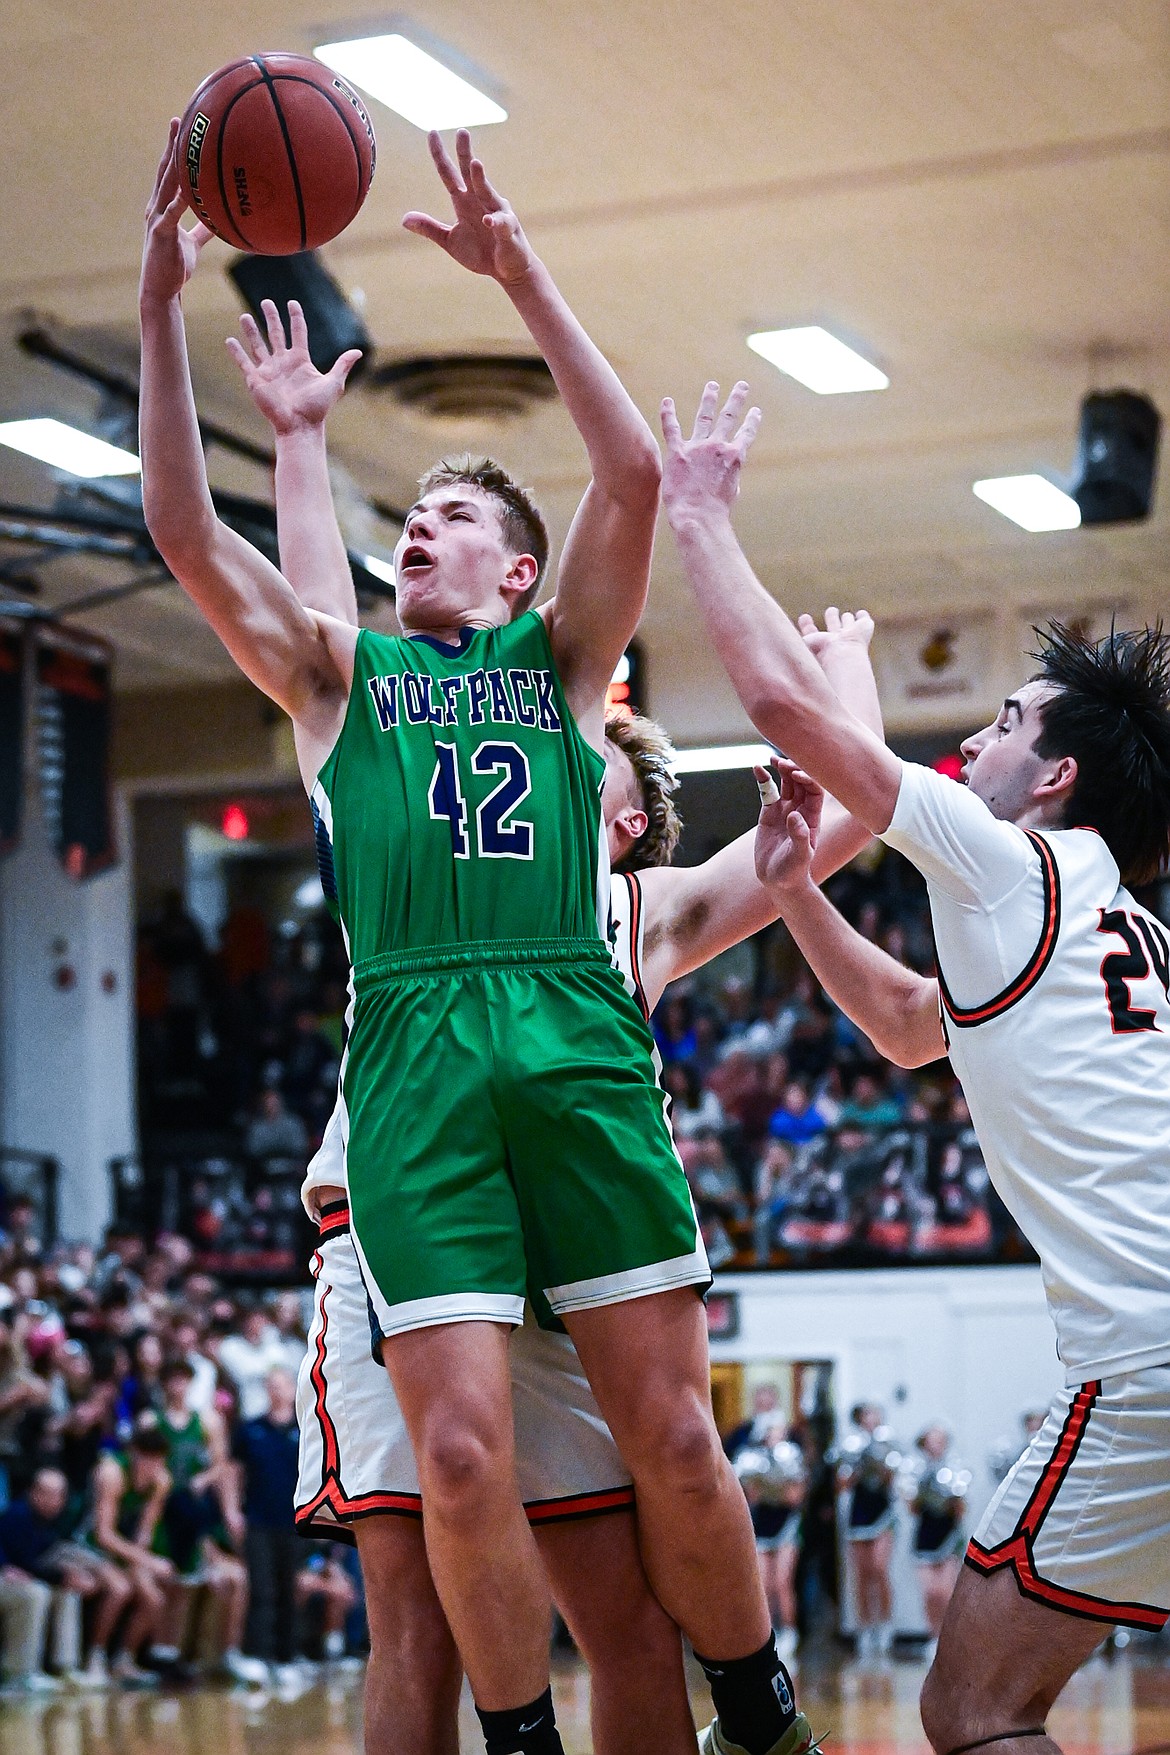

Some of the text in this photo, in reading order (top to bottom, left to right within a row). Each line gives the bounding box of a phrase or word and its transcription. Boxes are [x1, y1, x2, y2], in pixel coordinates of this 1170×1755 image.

[188, 115, 207, 163] PRO
[233, 167, 251, 206] NFHS
[368, 668, 562, 732] WOLFPACK
[427, 740, 534, 860] 42
